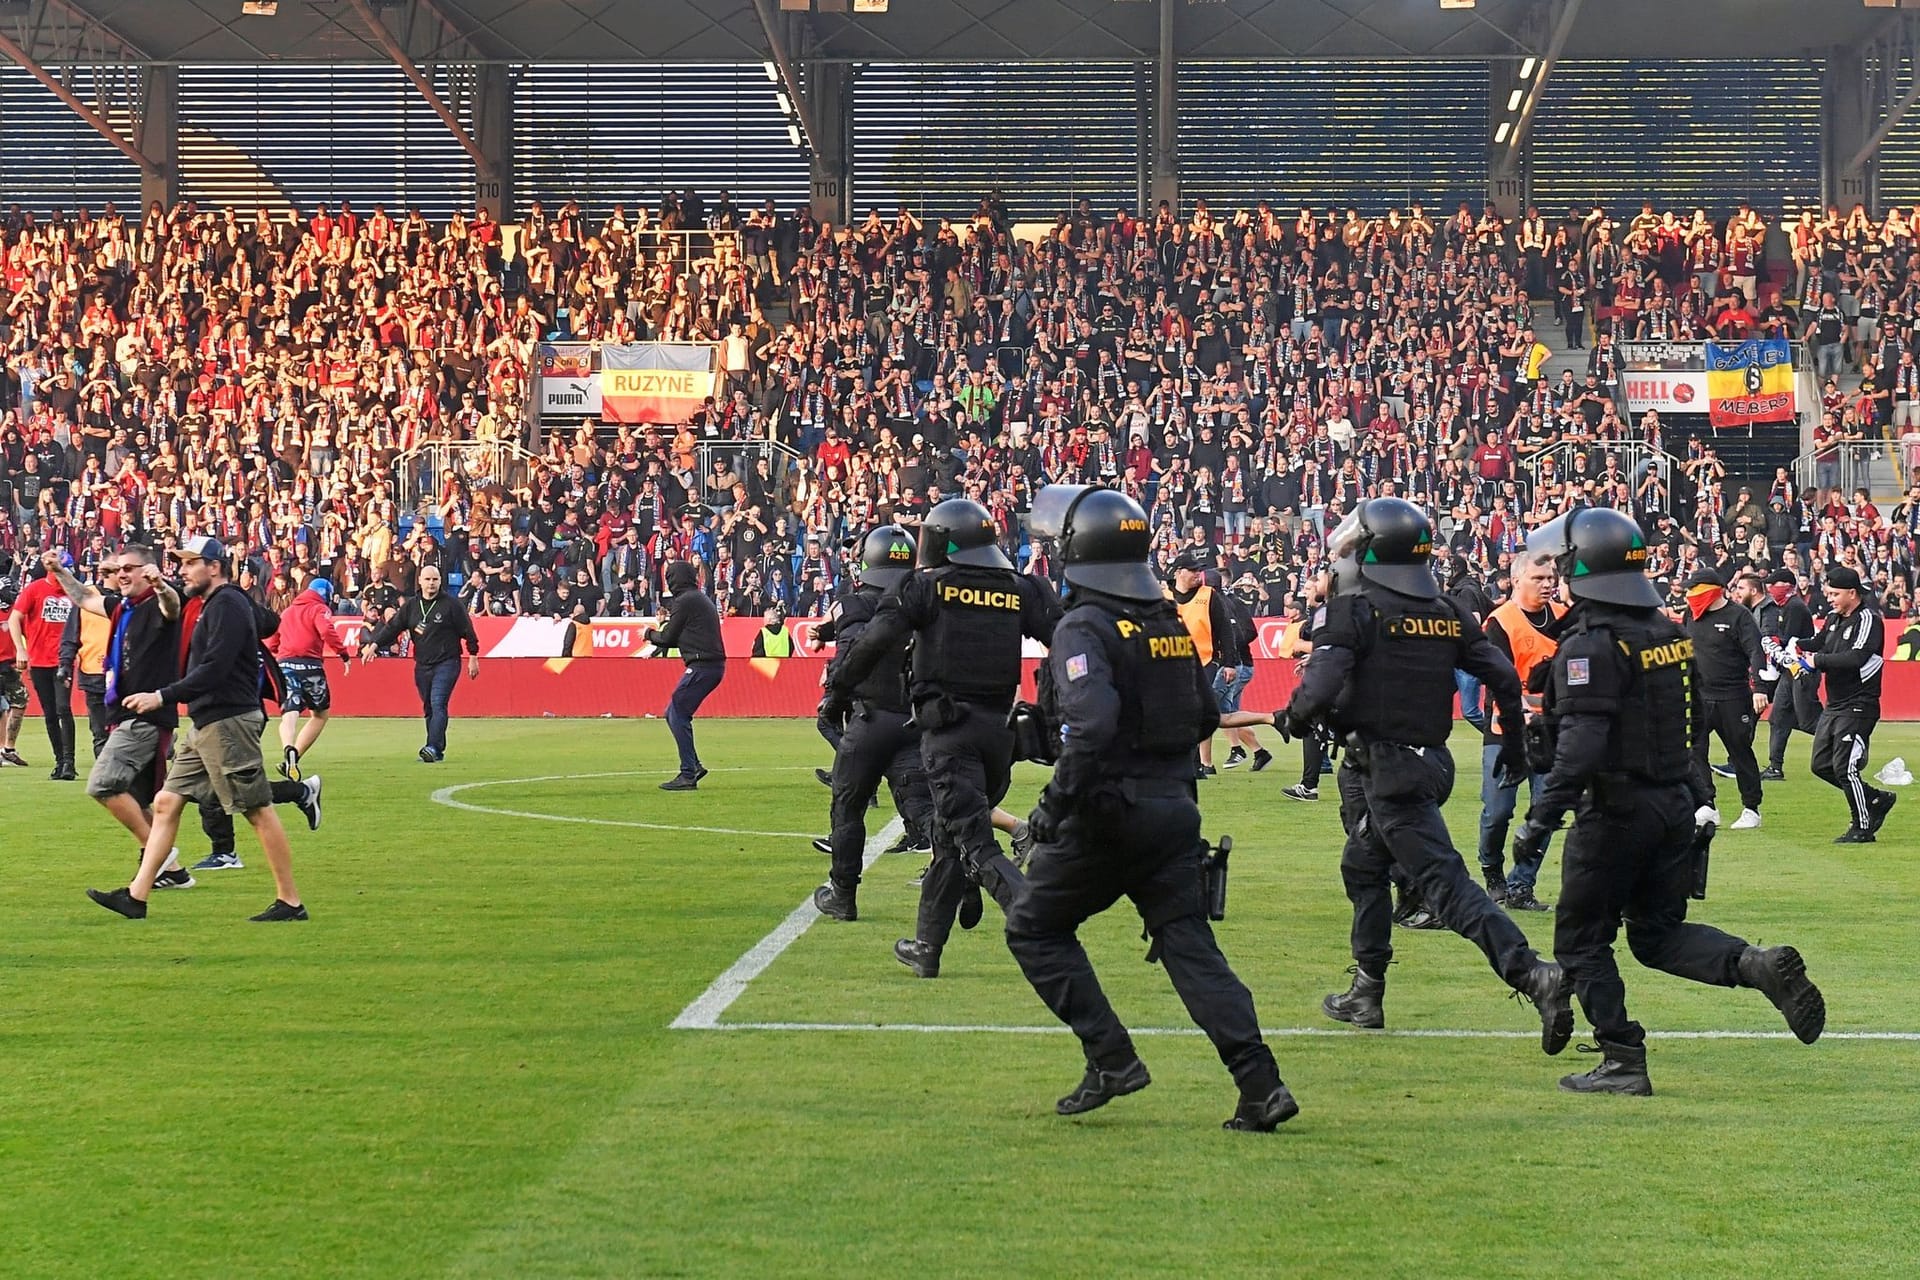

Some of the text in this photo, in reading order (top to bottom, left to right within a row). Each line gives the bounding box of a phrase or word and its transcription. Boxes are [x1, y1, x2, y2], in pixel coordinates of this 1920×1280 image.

[477, 183, 499, 198] T10
[814, 182, 836, 197] T10
[1496, 180, 1516, 196] T11
[1841, 179, 1862, 195] T11
[615, 373, 694, 393] RUZYNĚ
[1626, 381, 1669, 399] HELL
[548, 394, 583, 404] PUMA
[1120, 520, 1146, 530] A001
[944, 586, 1020, 611] POLICIE
[1390, 618, 1462, 637] OLICIE
[592, 629, 630, 648] MOL
[1149, 636, 1193, 657] POLICIE
[1640, 640, 1694, 668] POLICIE
